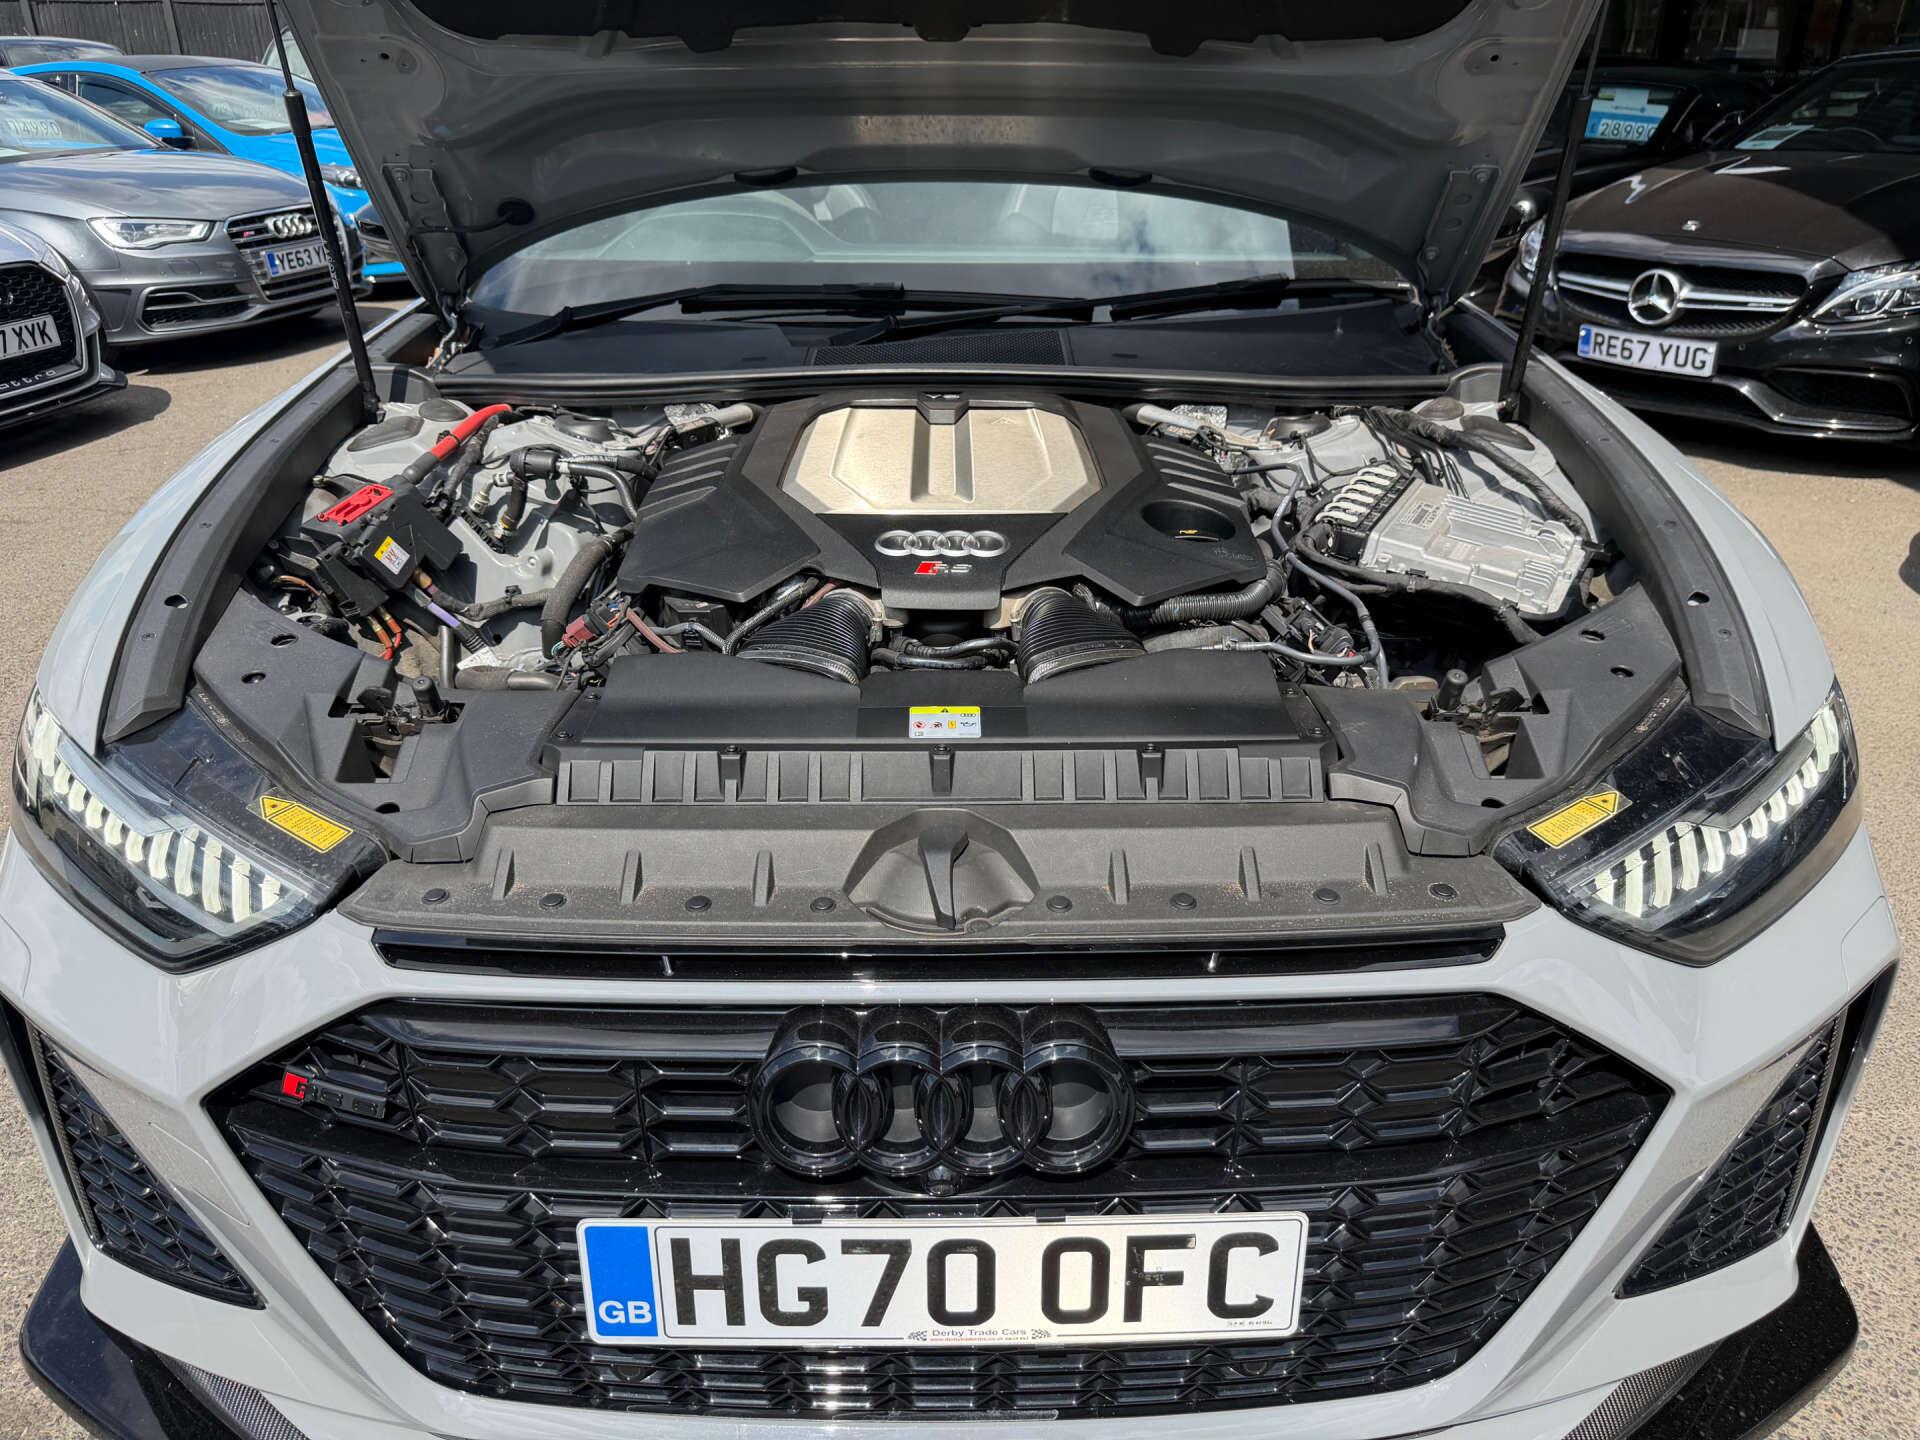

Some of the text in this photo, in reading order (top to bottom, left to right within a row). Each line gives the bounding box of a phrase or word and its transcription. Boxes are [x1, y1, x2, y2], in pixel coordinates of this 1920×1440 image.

[276, 248, 313, 271] YE63
[11, 319, 53, 350] XYK
[1592, 332, 1710, 371] RE67 YUG
[670, 1231, 1279, 1327] HG70 OFC
[598, 1300, 653, 1324] GB
[932, 1328, 965, 1337] Derby
[1001, 1328, 1027, 1336] Cars
